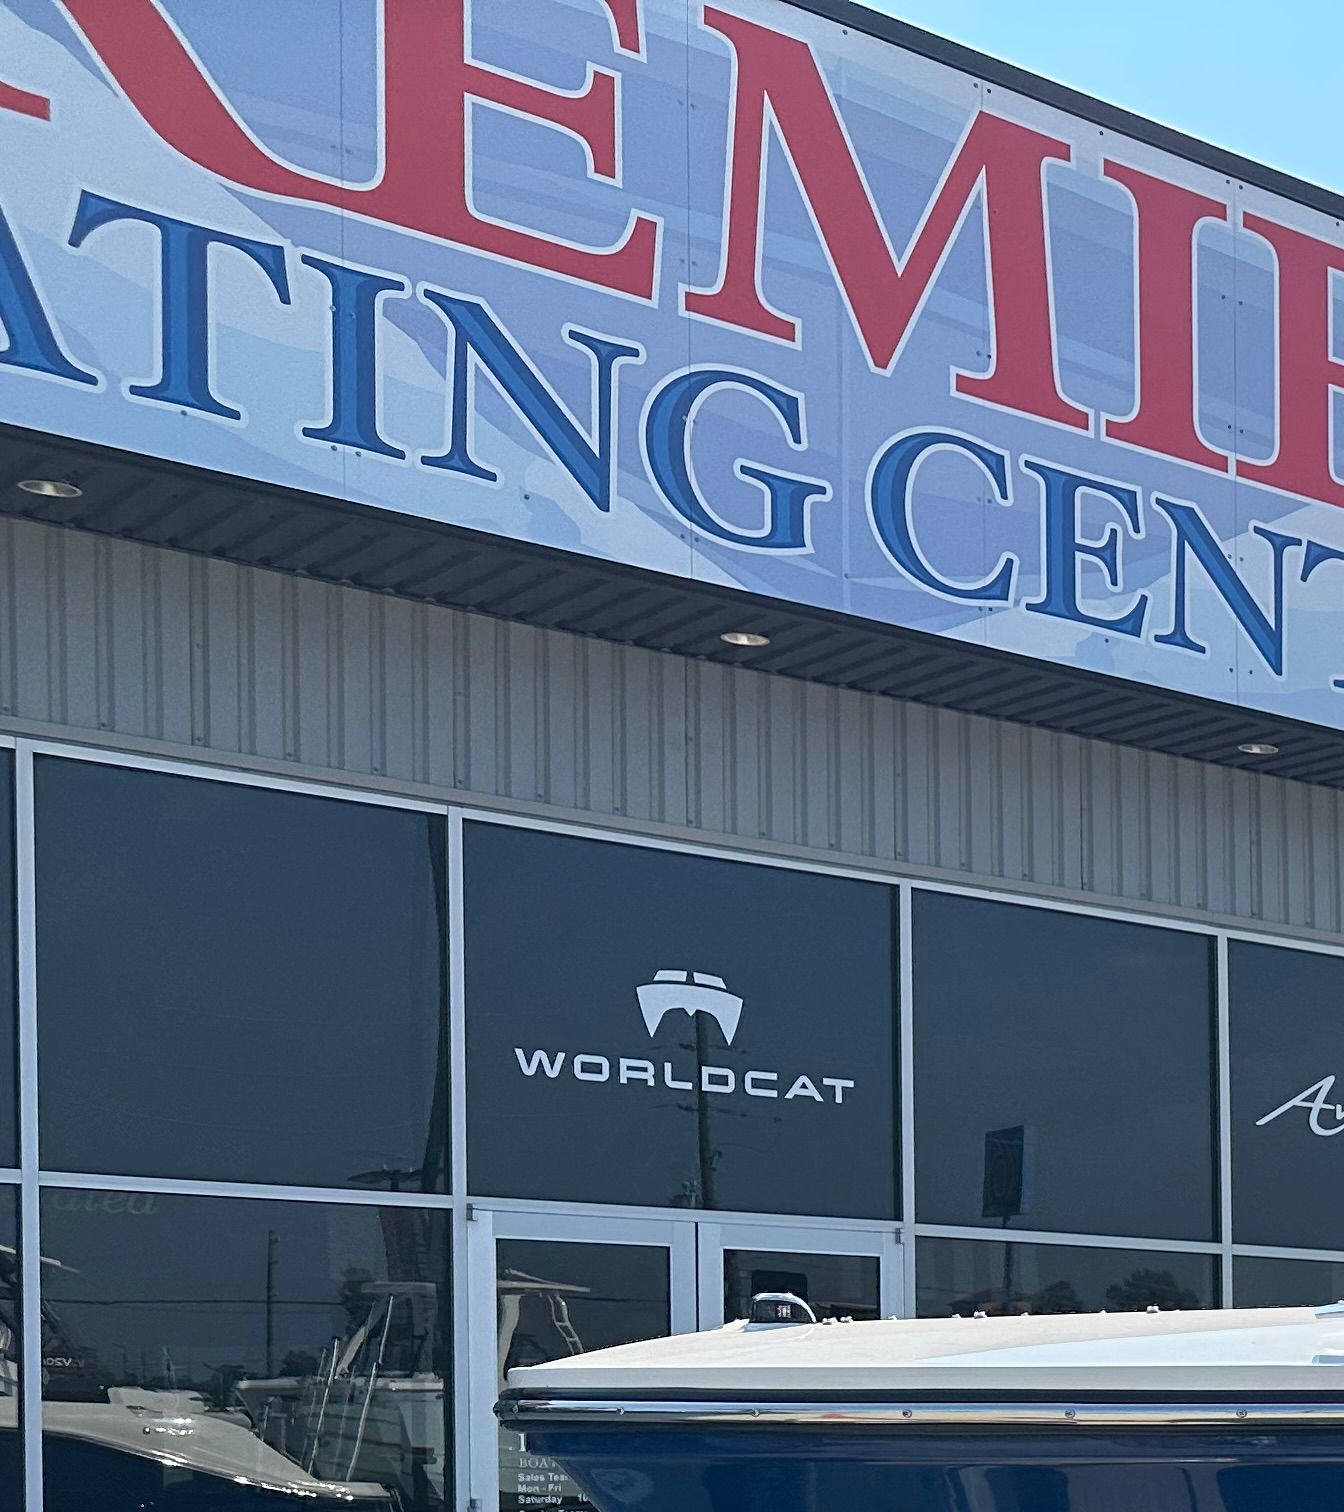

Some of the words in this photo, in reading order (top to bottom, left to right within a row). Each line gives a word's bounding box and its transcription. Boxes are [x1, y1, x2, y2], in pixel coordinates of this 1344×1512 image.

[514, 1046, 855, 1105] WORLDCAT
[518, 1472, 545, 1482] Sales
[517, 1484, 540, 1493] Mon
[548, 1483, 562, 1492] Fri
[518, 1494, 563, 1505] Saturday
